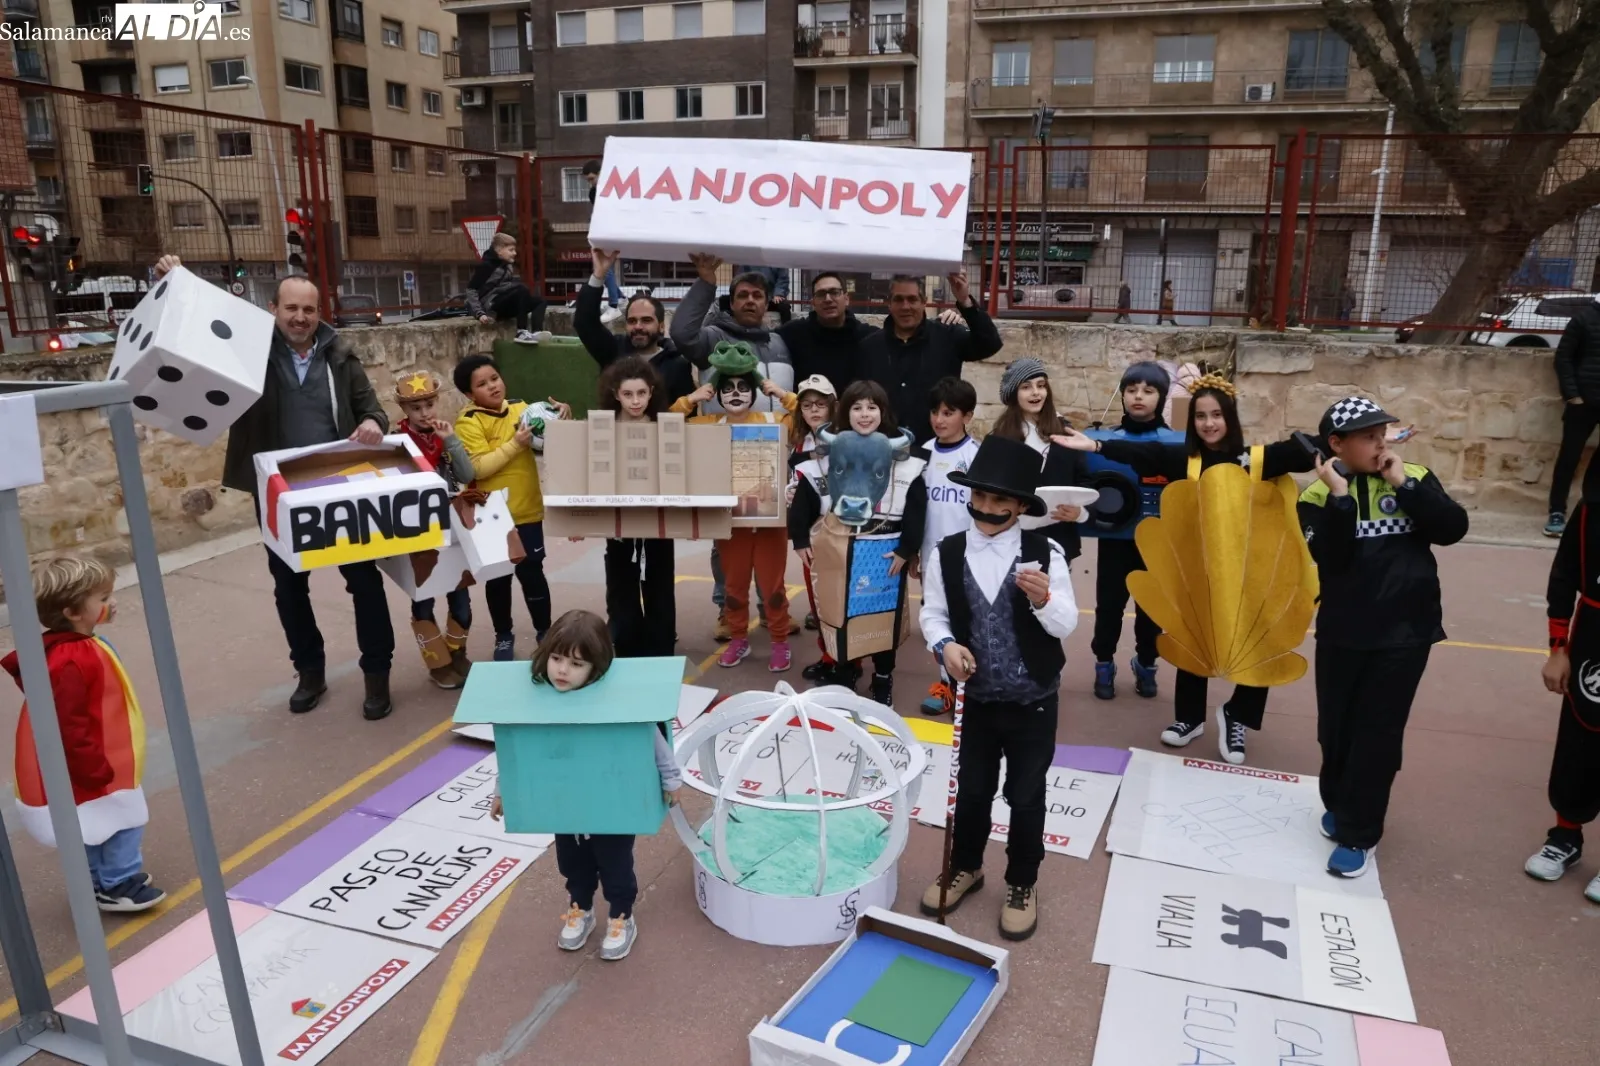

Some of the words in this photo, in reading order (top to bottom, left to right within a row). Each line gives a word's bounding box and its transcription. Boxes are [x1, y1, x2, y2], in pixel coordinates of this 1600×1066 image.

[600, 166, 966, 219] MANJONPOLY
[290, 487, 451, 553] BANCA
[437, 765, 498, 803] CALLE
[1187, 760, 1298, 783] MANJONPOLY
[309, 848, 409, 913] PASEO
[377, 845, 493, 931] CANALEJAS
[395, 851, 447, 880] DE
[436, 857, 516, 931] MANJONPOLY
[1156, 894, 1196, 949] VIALIA
[1320, 912, 1372, 992] ESTACIÓN
[290, 959, 403, 1058] MANJONPOLY
